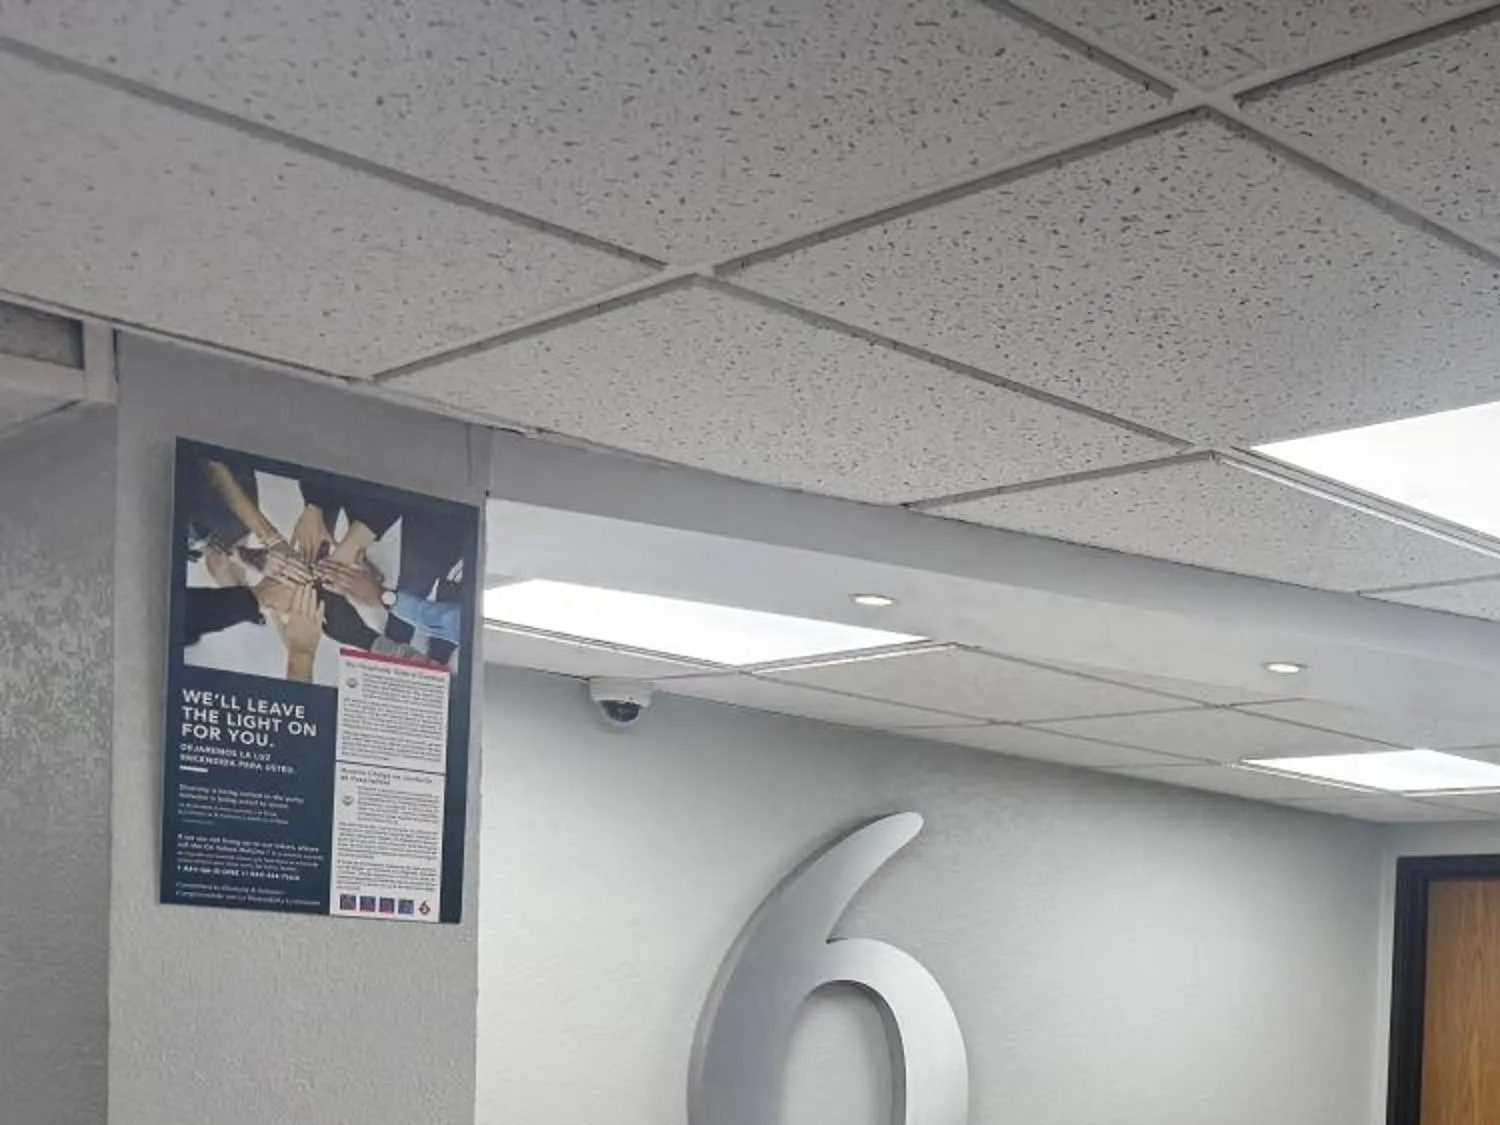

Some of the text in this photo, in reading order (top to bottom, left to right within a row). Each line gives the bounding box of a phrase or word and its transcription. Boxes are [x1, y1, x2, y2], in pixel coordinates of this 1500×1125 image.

[247, 697, 305, 719] LEAVE
[182, 705, 317, 737] THE LIGHT ON
[181, 723, 274, 748] FOR YOU.
